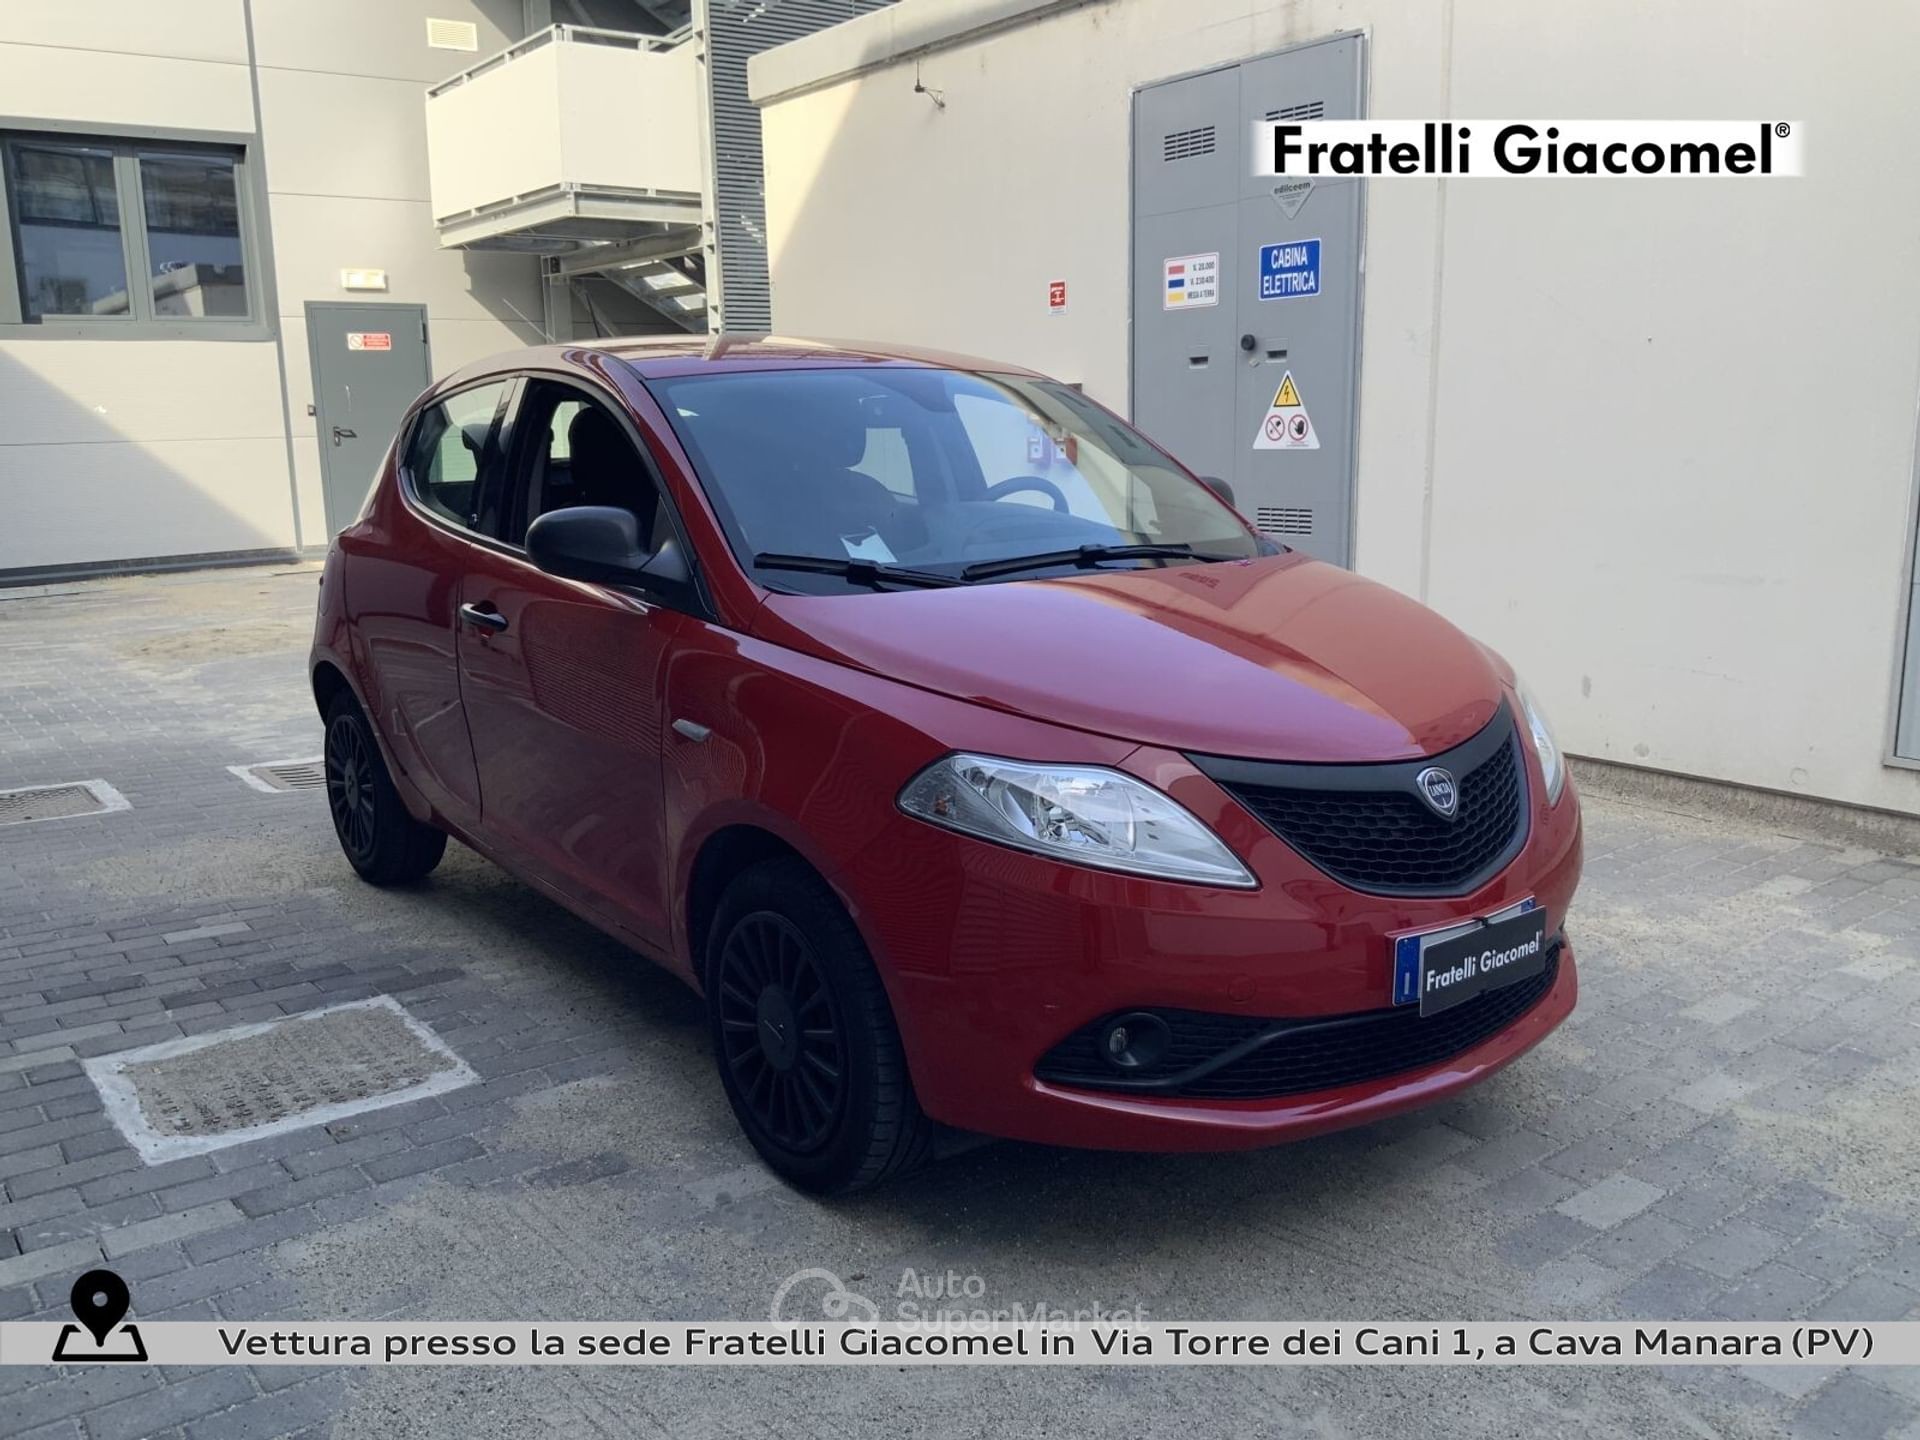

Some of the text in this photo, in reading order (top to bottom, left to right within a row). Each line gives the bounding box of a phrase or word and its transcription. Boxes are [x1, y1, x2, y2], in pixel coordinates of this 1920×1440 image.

[1271, 246, 1308, 269] CABINA
[1263, 271, 1316, 295] ELETTRICA
[1429, 783, 1450, 797] LANCIA
[1426, 956, 1477, 992] Fratelli
